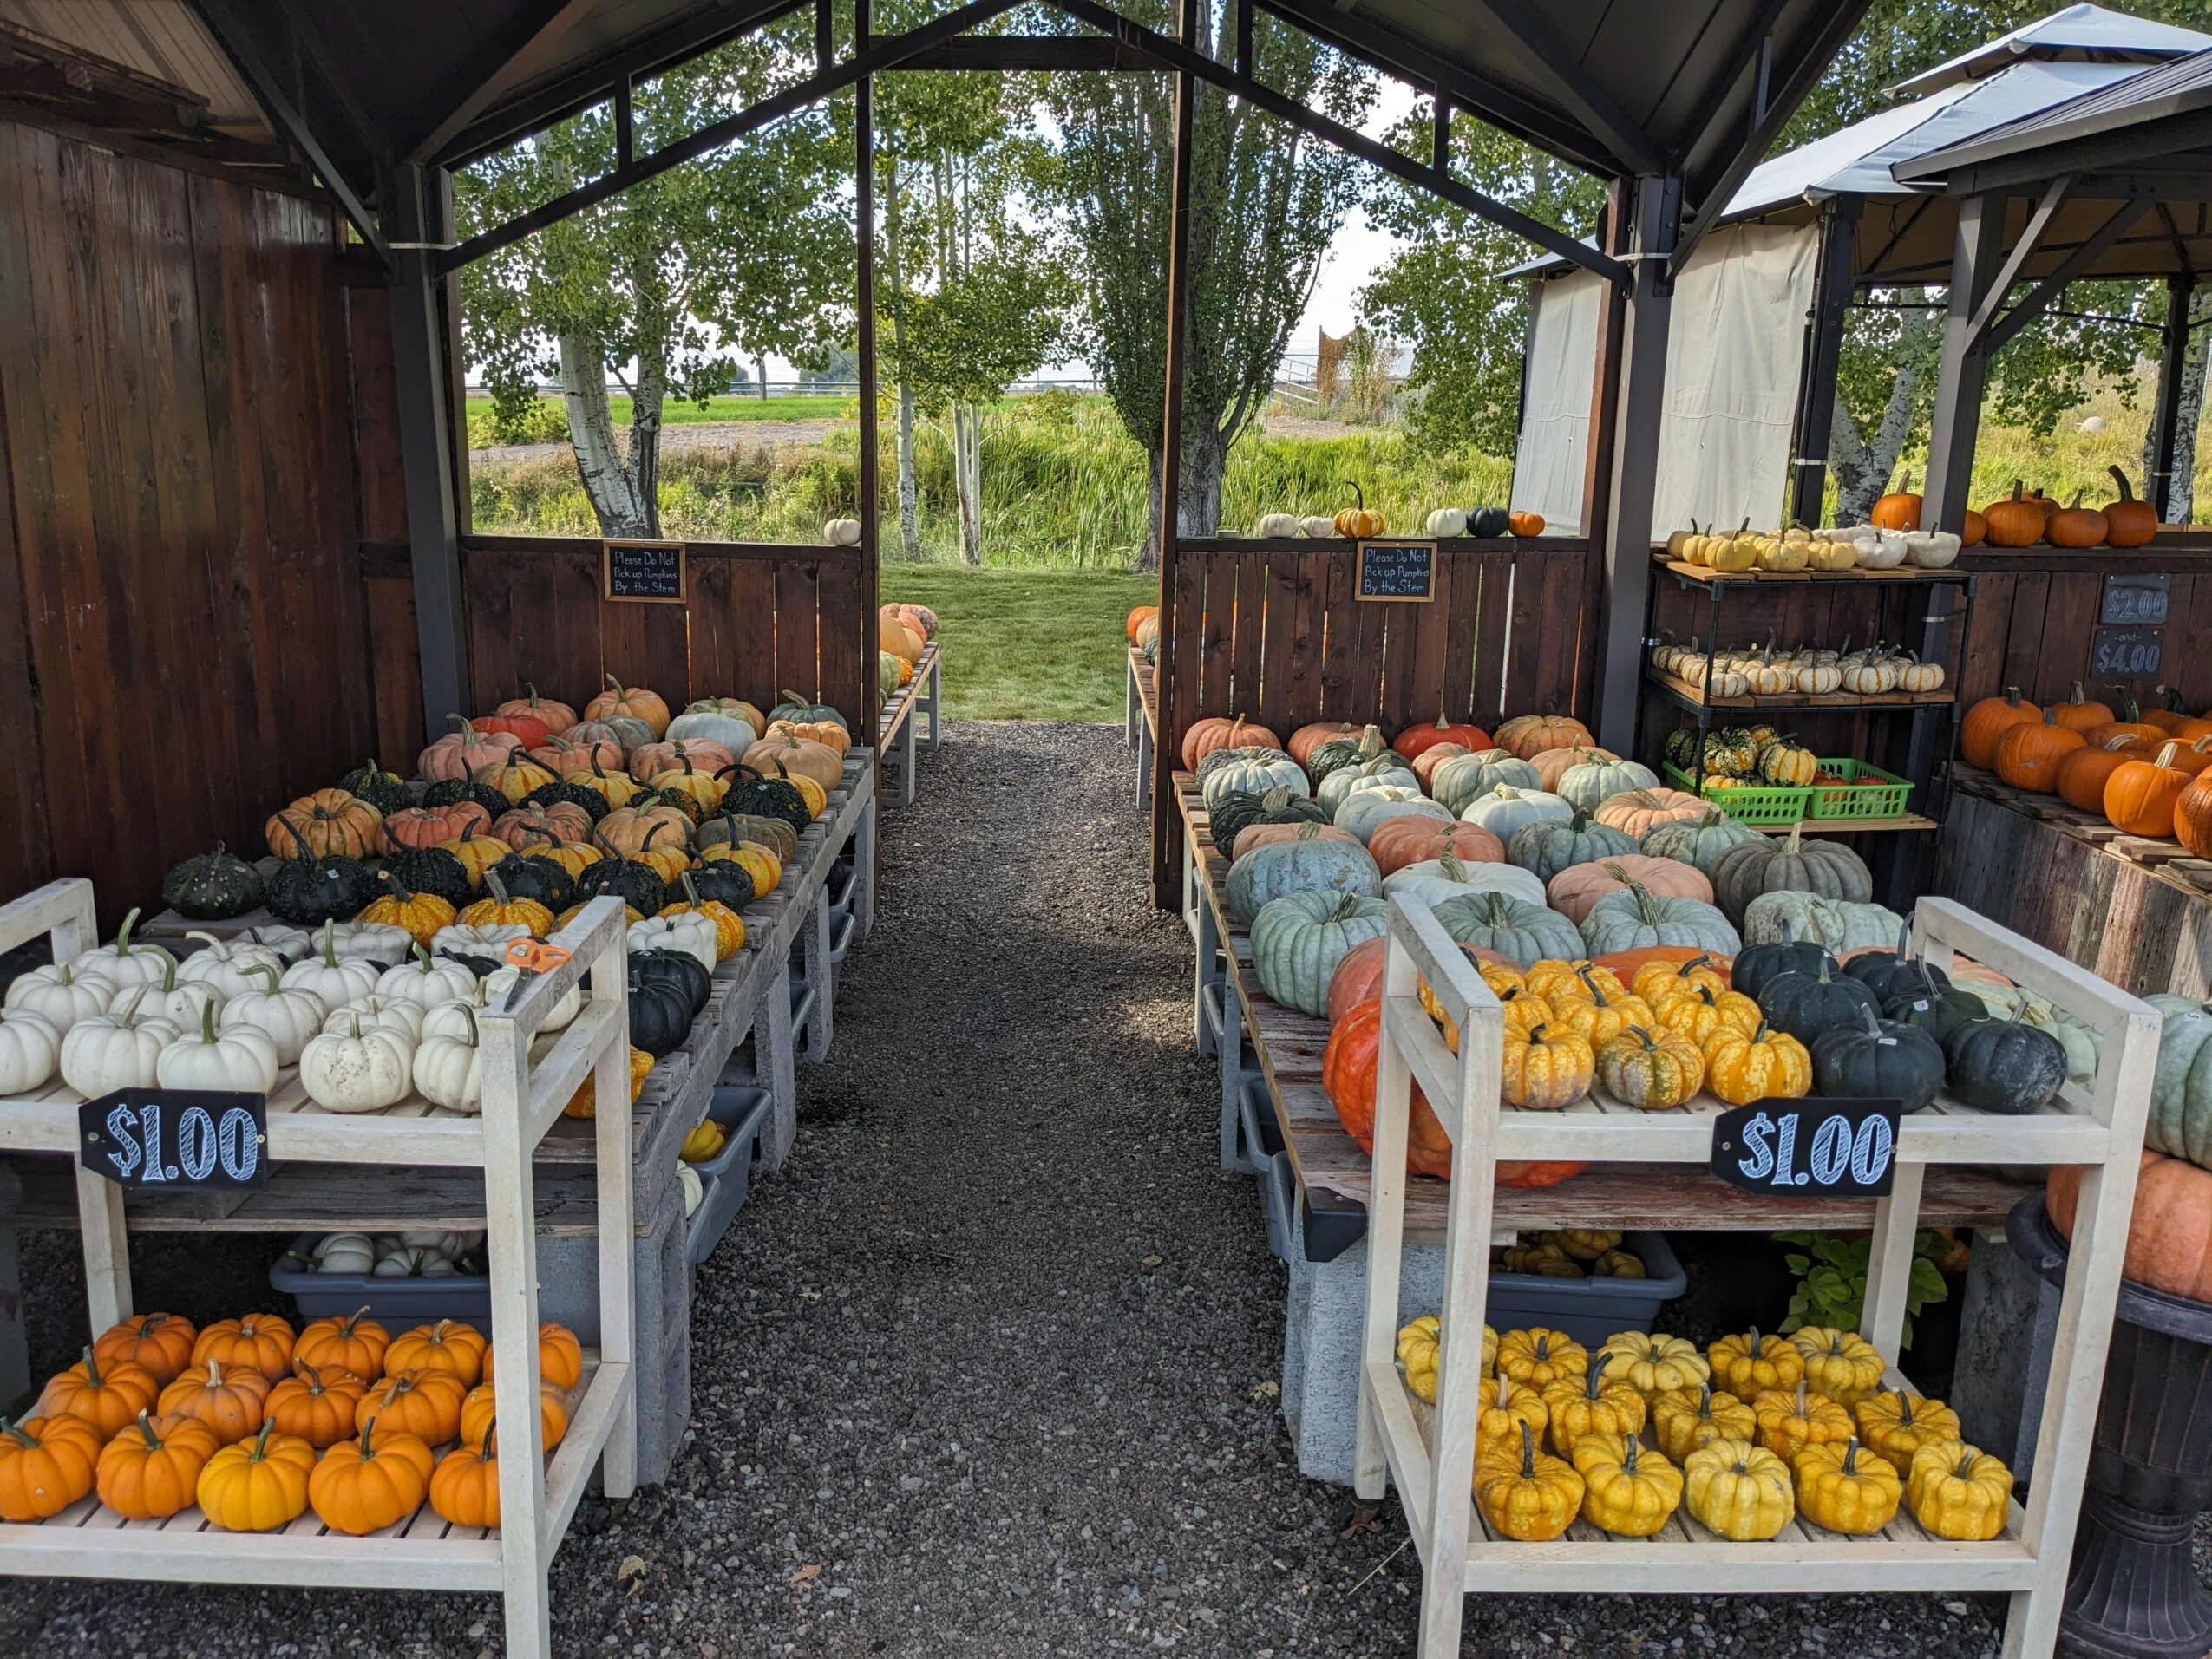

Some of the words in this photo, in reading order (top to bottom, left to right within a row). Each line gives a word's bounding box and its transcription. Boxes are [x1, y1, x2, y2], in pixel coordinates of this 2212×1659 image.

[614, 551, 642, 565] Please
[644, 552, 657, 565] Do
[659, 552, 676, 565] Not
[1365, 548, 1394, 563] Please
[1396, 549, 1407, 563] Do
[1410, 549, 1428, 563] Not
[614, 566, 630, 578] Pick
[632, 571, 642, 580] up
[644, 567, 677, 581] Pumpkins
[1365, 565, 1382, 577] Pick
[1384, 569, 1396, 579] up
[1397, 565, 1430, 579] Pumpkins
[615, 580, 628, 594] By
[634, 581, 649, 591] the
[651, 582, 675, 593] Stem
[1365, 579, 1377, 595] By
[1381, 579, 1396, 592] the
[1397, 579, 1424, 593] Stem
[2108, 589, 2168, 619] $2.00
[2097, 644, 2160, 673] $4.00
[107, 1103, 258, 1182] $1.00
[1738, 1112, 1893, 1186] $1.00
